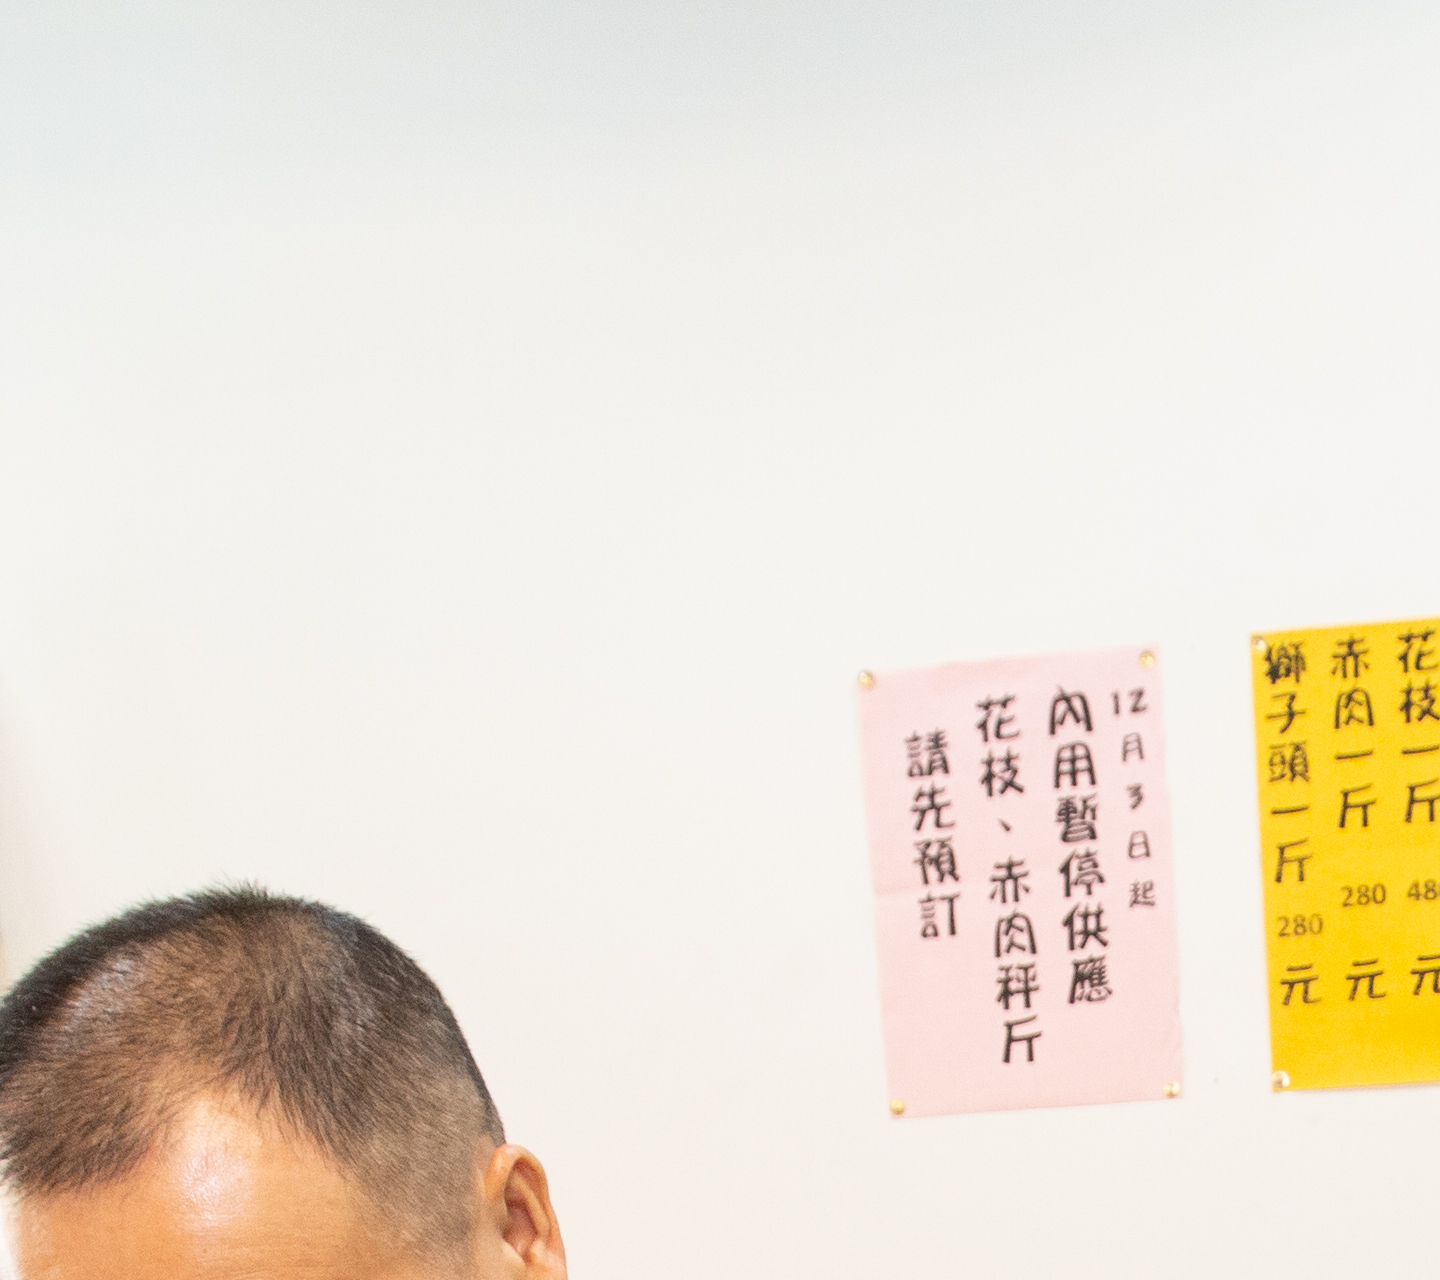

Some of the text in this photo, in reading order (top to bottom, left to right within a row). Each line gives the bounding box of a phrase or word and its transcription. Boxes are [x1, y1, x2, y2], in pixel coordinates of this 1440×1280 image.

[903, 727, 962, 940] 請先預訂
[1111, 687, 1157, 909] 12月3日起
[1263, 640, 1324, 1007] 獅子頭一斤 280 元
[1330, 634, 1388, 1002] 赤肉一斤 280 元
